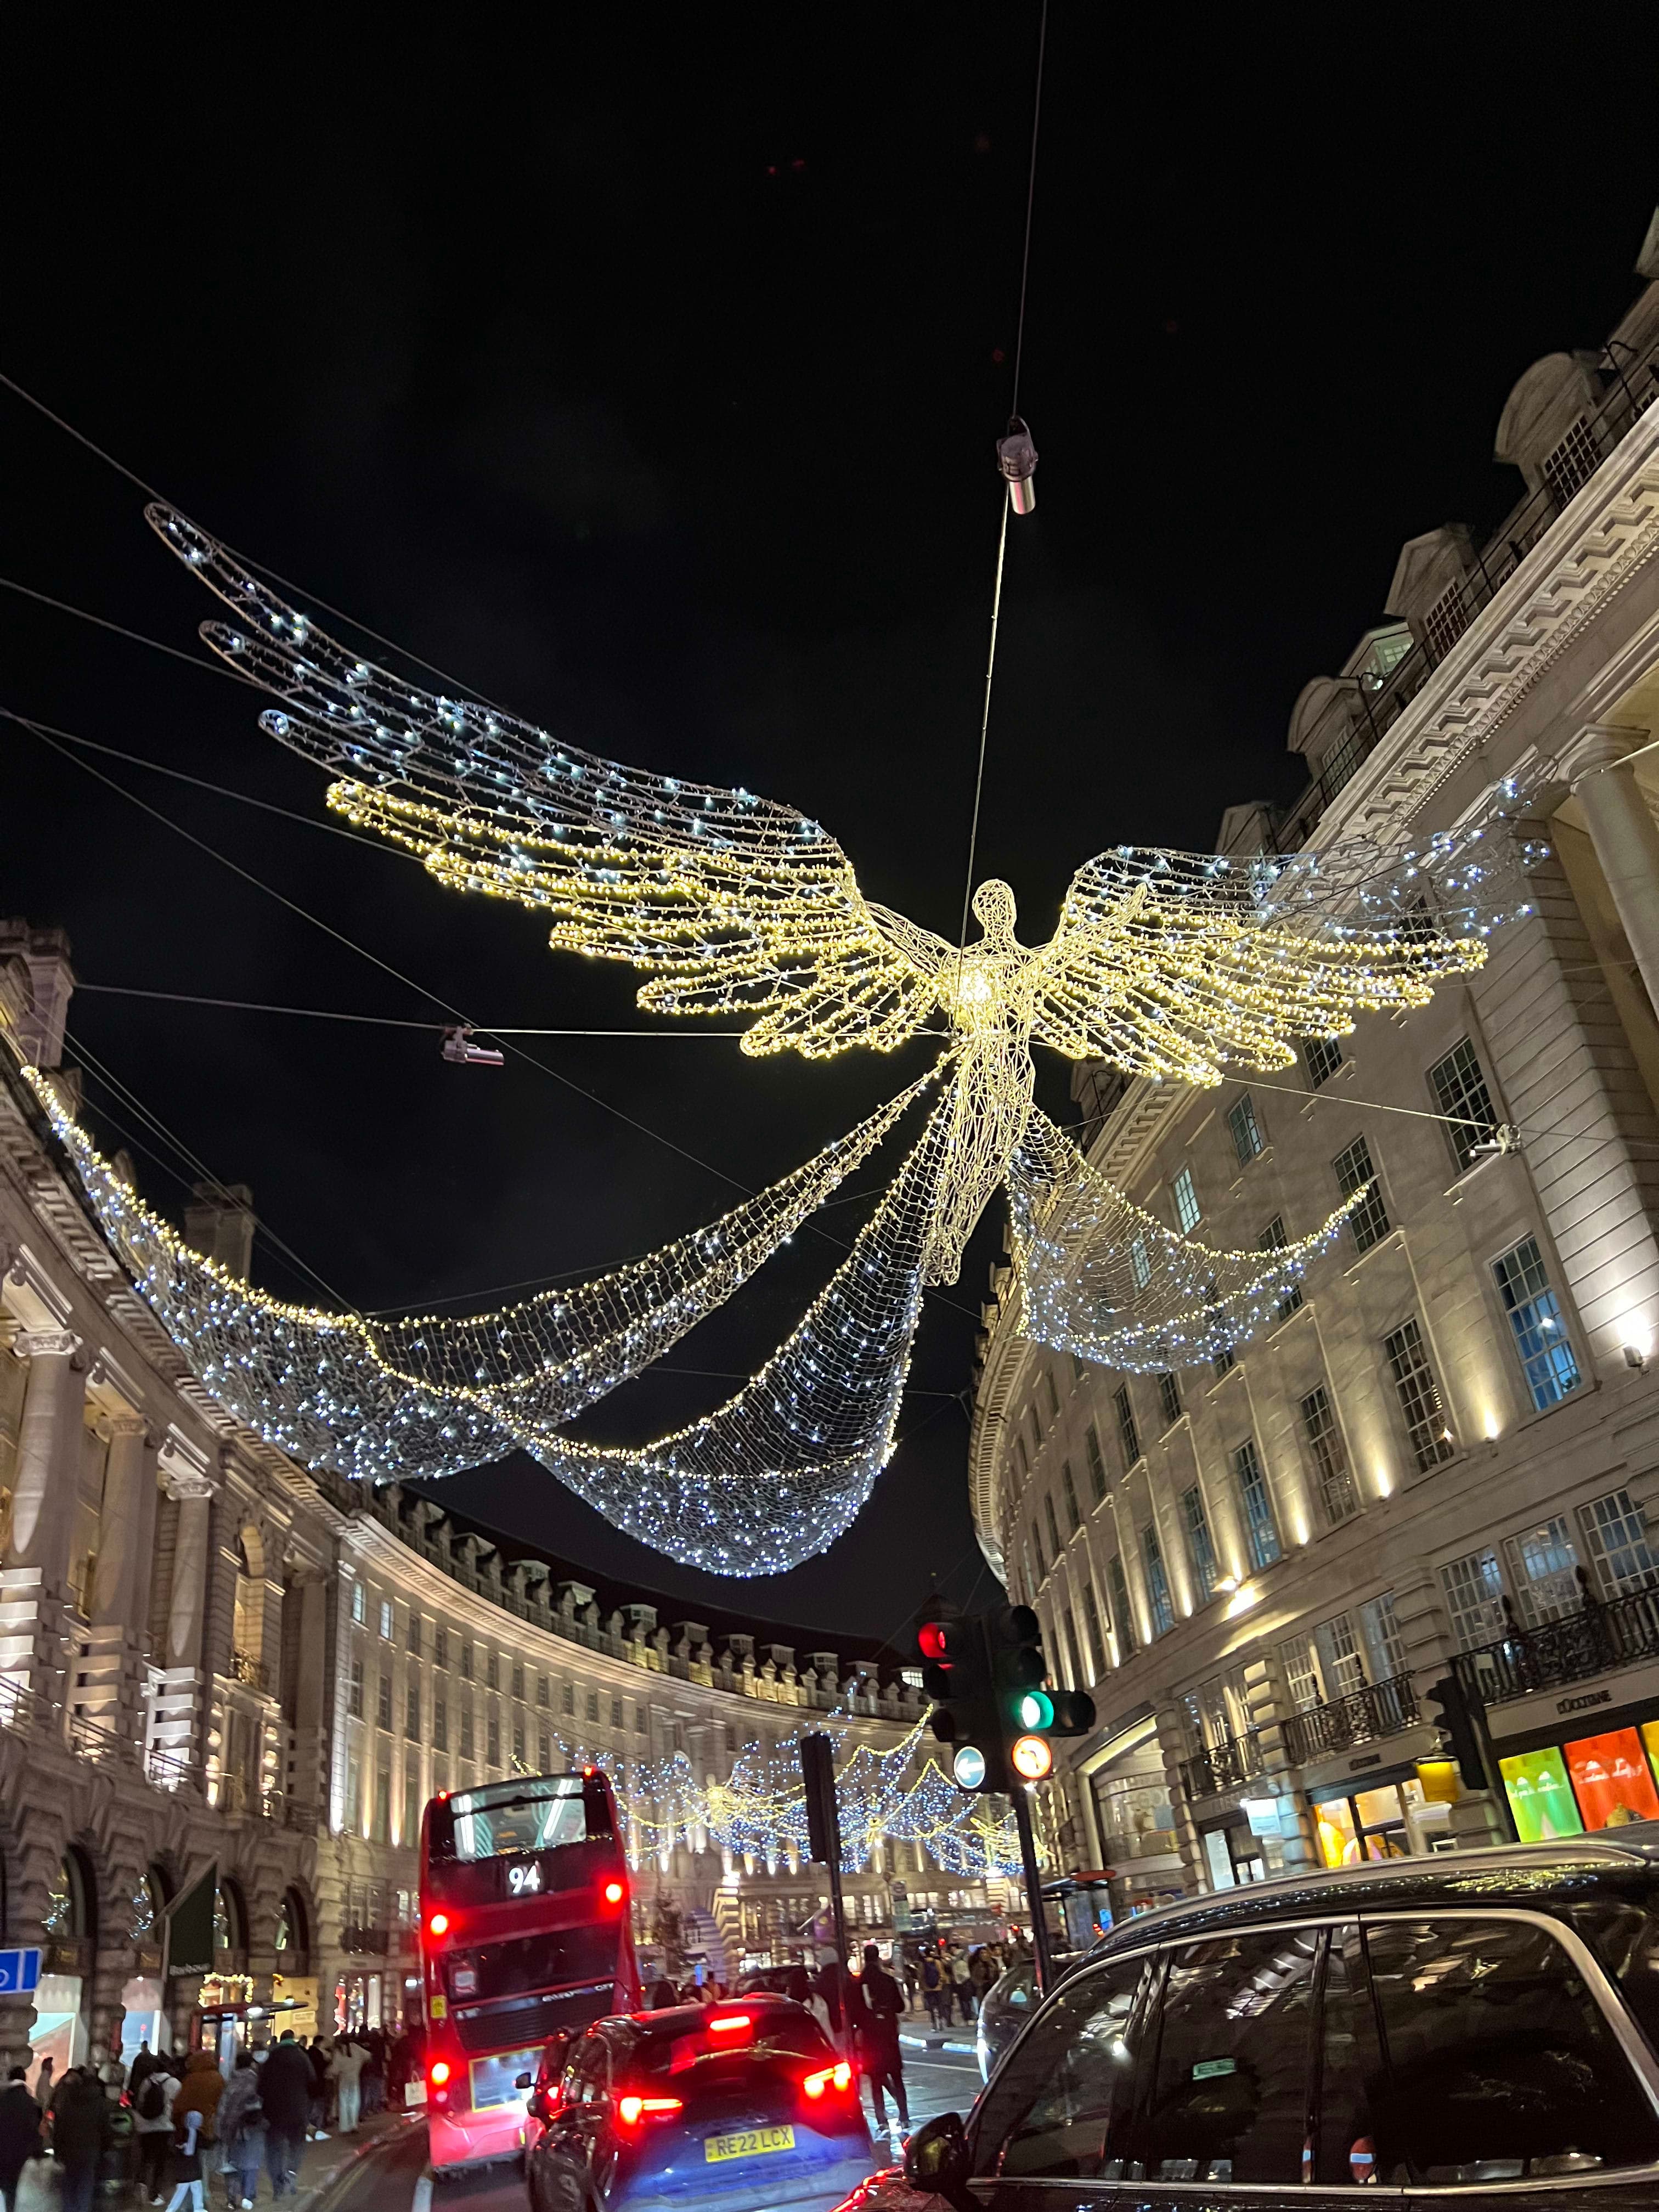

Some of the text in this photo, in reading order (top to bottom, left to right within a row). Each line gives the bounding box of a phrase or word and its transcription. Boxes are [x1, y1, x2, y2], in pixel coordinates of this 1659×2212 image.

[509, 1865, 540, 1893] 94
[716, 2127, 791, 2156] RE22 LCX
